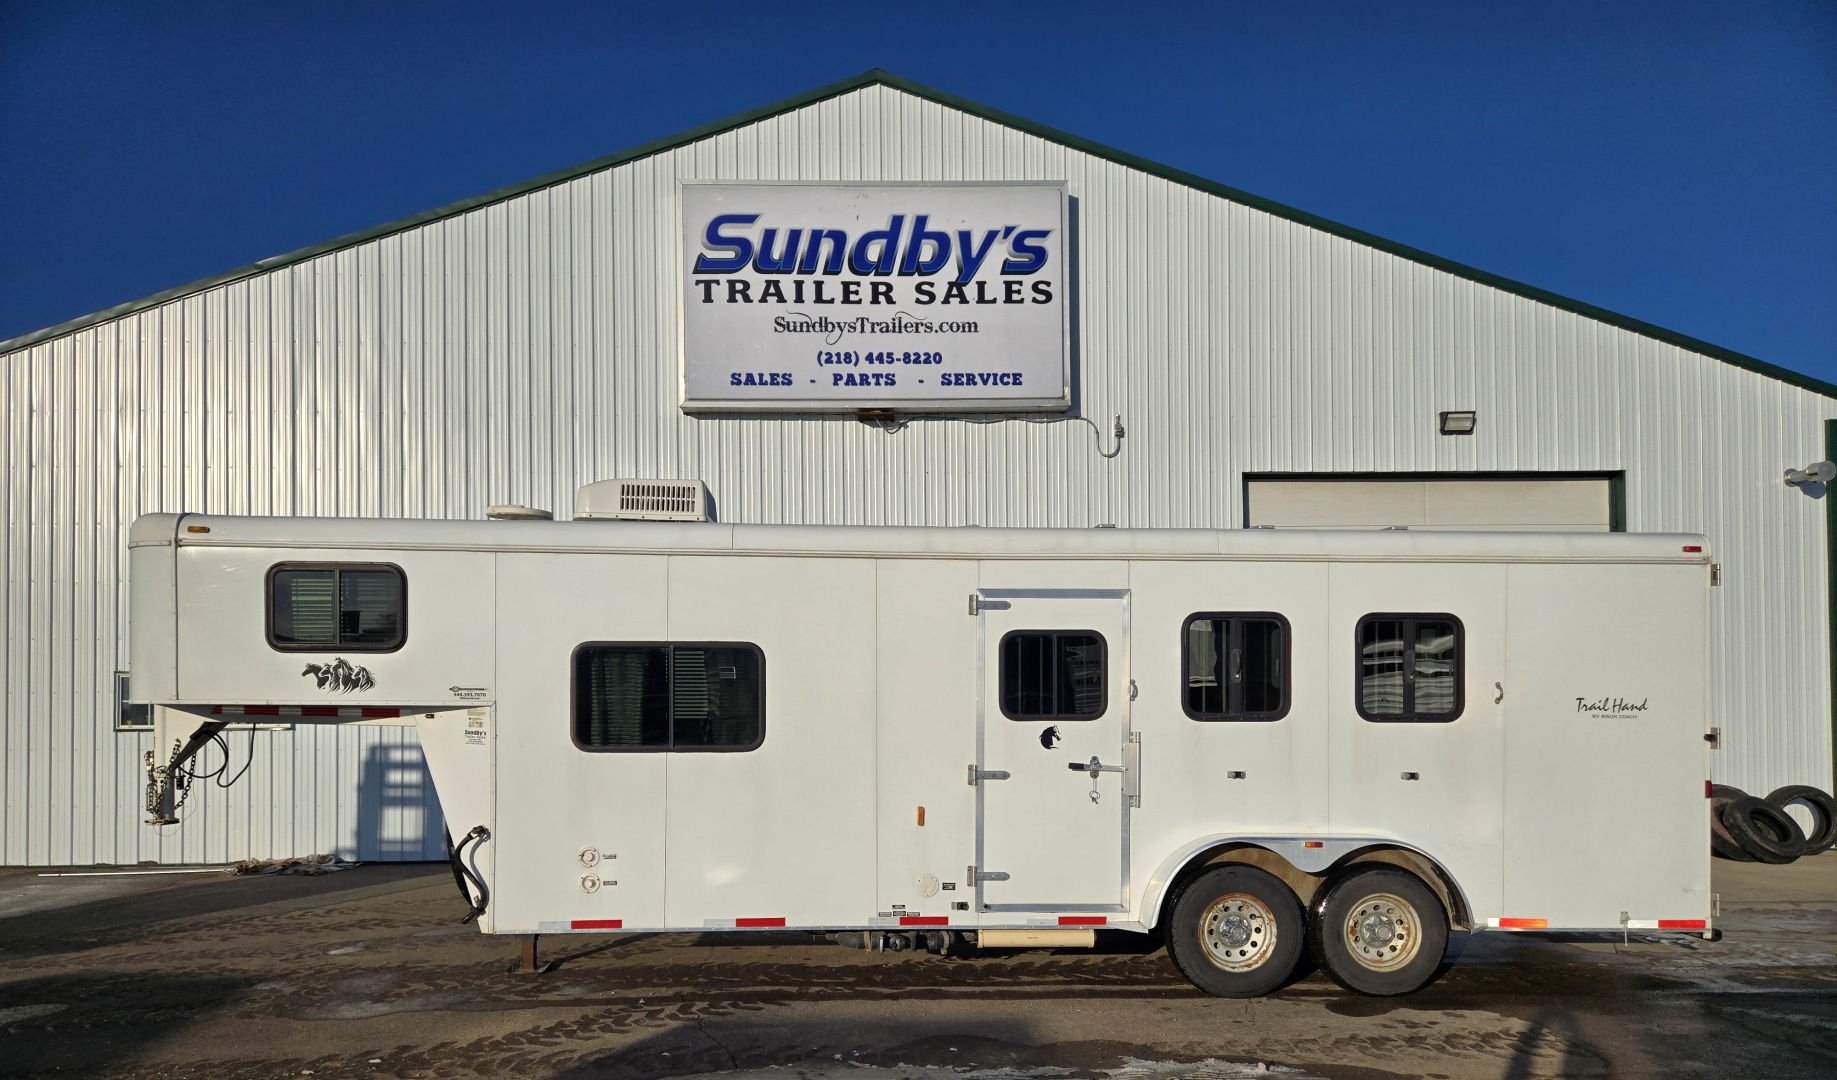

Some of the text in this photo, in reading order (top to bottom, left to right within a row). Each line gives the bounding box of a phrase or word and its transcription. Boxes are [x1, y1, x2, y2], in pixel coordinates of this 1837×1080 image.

[692, 213, 1055, 287] Sundby's
[695, 279, 1054, 306] TRAILER SALES
[774, 309, 979, 346] SundbysTrailers.com
[817, 350, 943, 367] (218) 445-8220
[730, 372, 793, 386] SALES
[832, 372, 897, 387] PARTS
[940, 372, 1023, 387] SERVICE
[1575, 697, 1648, 713] Trail Hand
